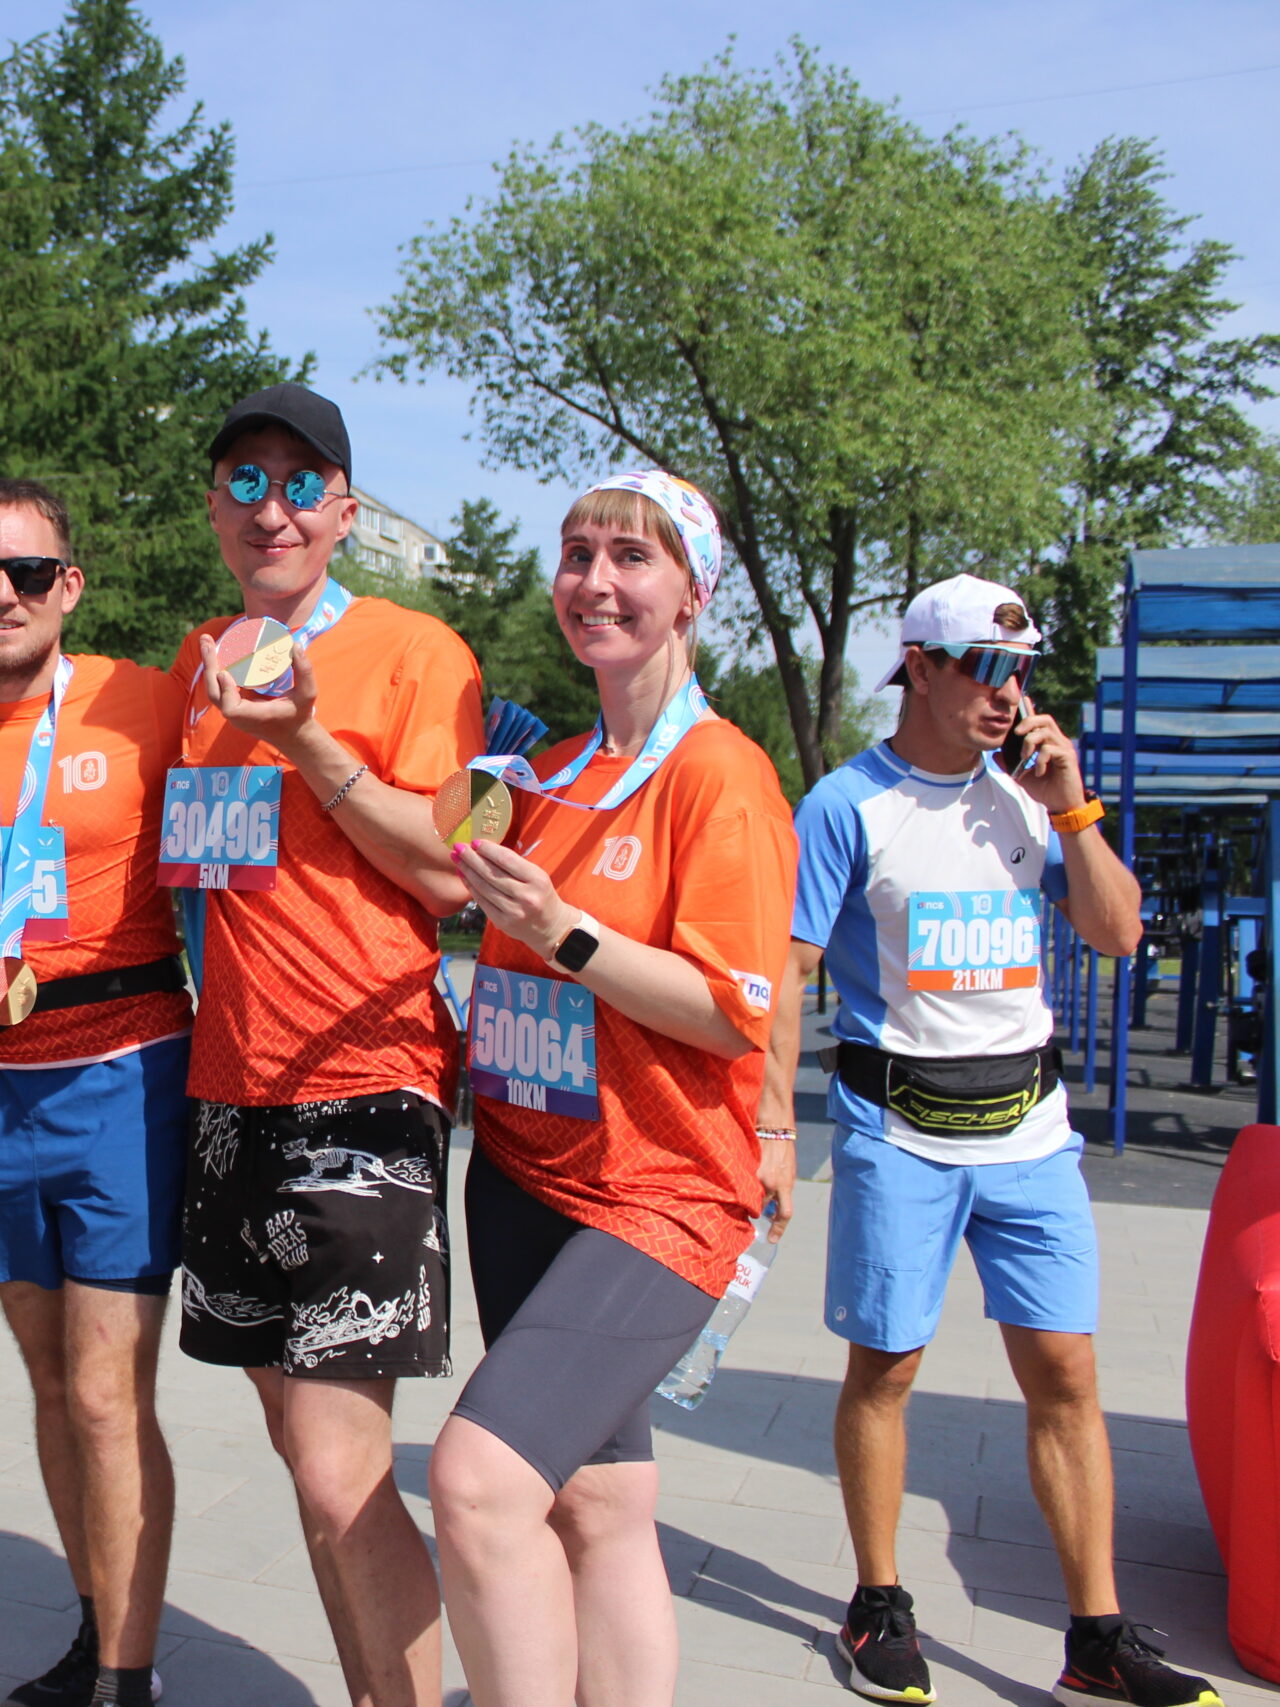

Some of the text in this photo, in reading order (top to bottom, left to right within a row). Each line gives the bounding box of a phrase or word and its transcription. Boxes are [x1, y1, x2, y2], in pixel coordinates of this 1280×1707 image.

[56, 751, 107, 794] 10
[210, 771, 230, 797] 10
[168, 801, 270, 860] 30496
[591, 835, 642, 880] 10
[971, 894, 993, 915] 10
[917, 916, 1034, 966] 70096
[517, 981, 538, 1010] 10
[476, 1003, 588, 1087] 50064
[910, 1100, 1020, 1125] FISCHER
[265, 1208, 296, 1239] BAD
[267, 1221, 308, 1261] IDEAS
